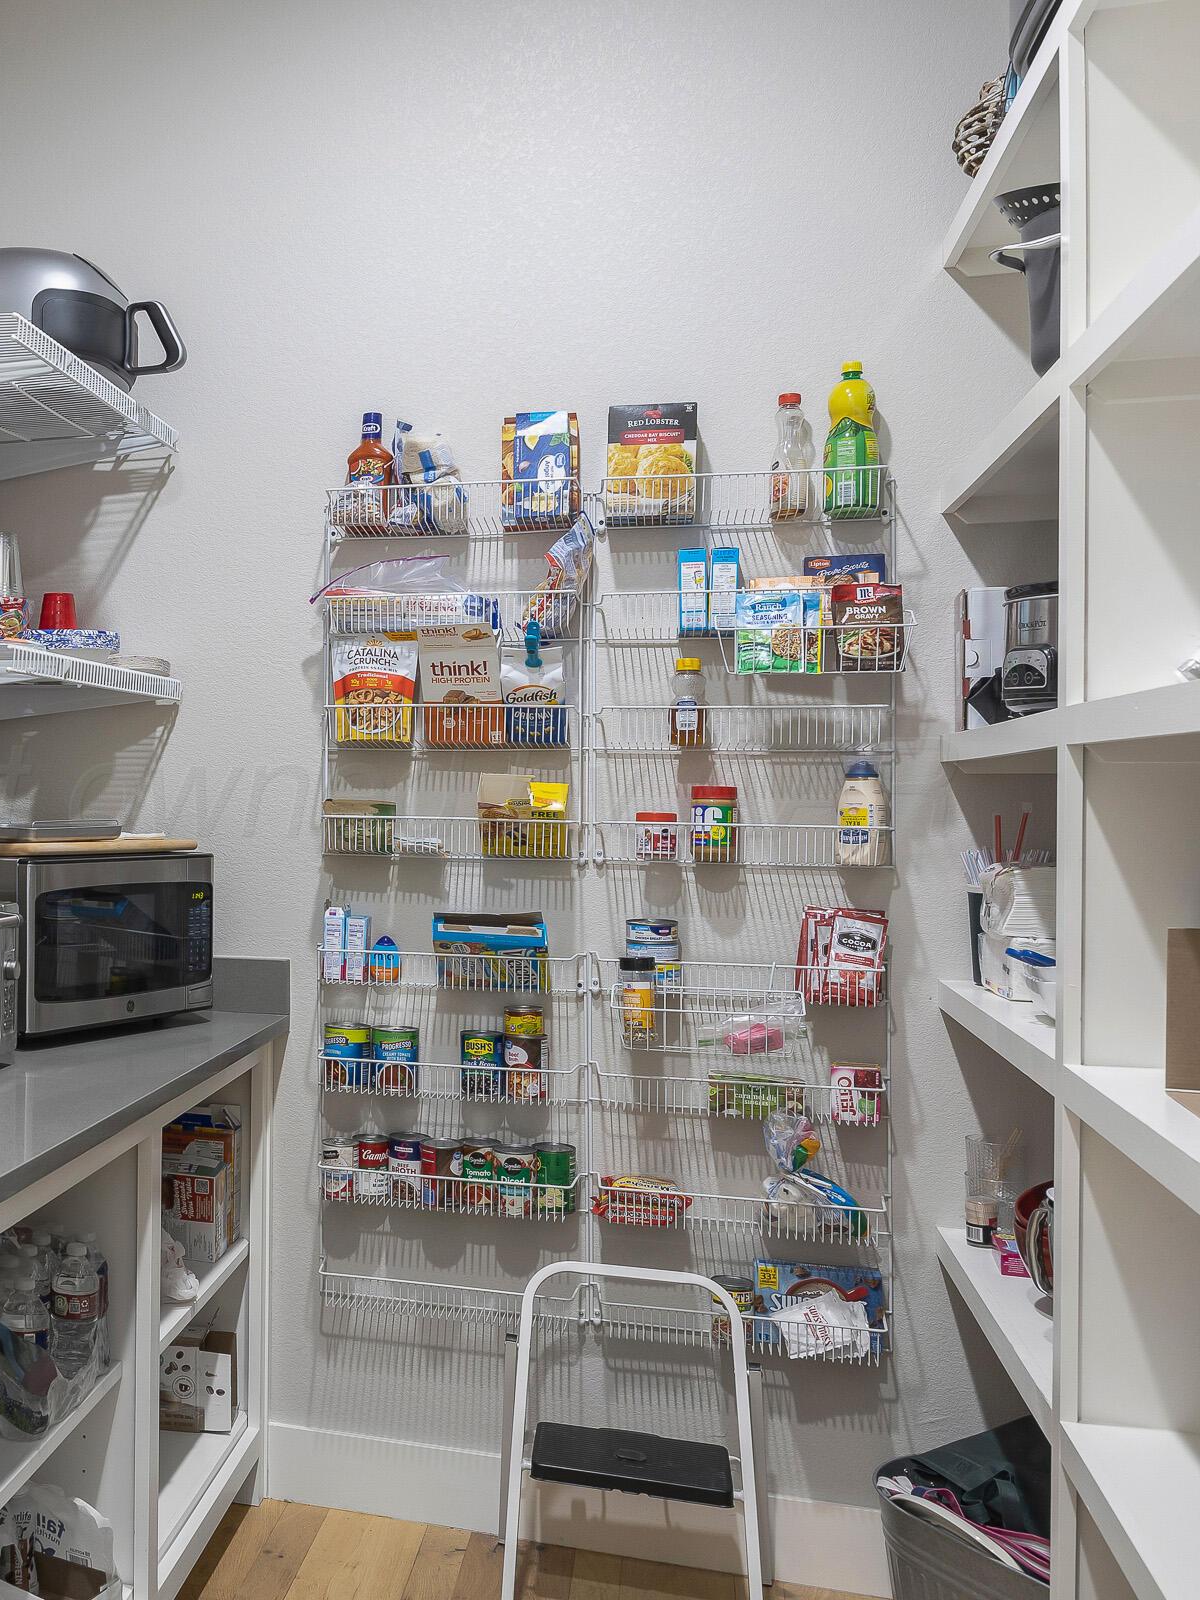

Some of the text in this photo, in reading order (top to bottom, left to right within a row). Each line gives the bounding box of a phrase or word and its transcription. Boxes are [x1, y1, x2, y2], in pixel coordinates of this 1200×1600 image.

[628, 418, 680, 428] RED LOBSTER
[809, 560, 830, 568] Lipton
[755, 602, 784, 611] Ranch
[846, 605, 887, 614] BROWN
[420, 627, 457, 635] think!
[347, 647, 399, 661] CATALINA
[353, 657, 391, 667] CRUNCH
[430, 660, 488, 677] think!
[454, 676, 491, 684] PROTEIN
[505, 688, 558, 705] Goldfish
[841, 938, 872, 948] COCOA
[381, 1040, 412, 1050] PROGRESSO
[465, 1041, 493, 1052] BUSH'S
[391, 1165, 417, 1174] BROTH
[465, 1168, 491, 1177] Tomato
[500, 1175, 525, 1183] Diced
[760, 1272, 777, 1280] 33%
